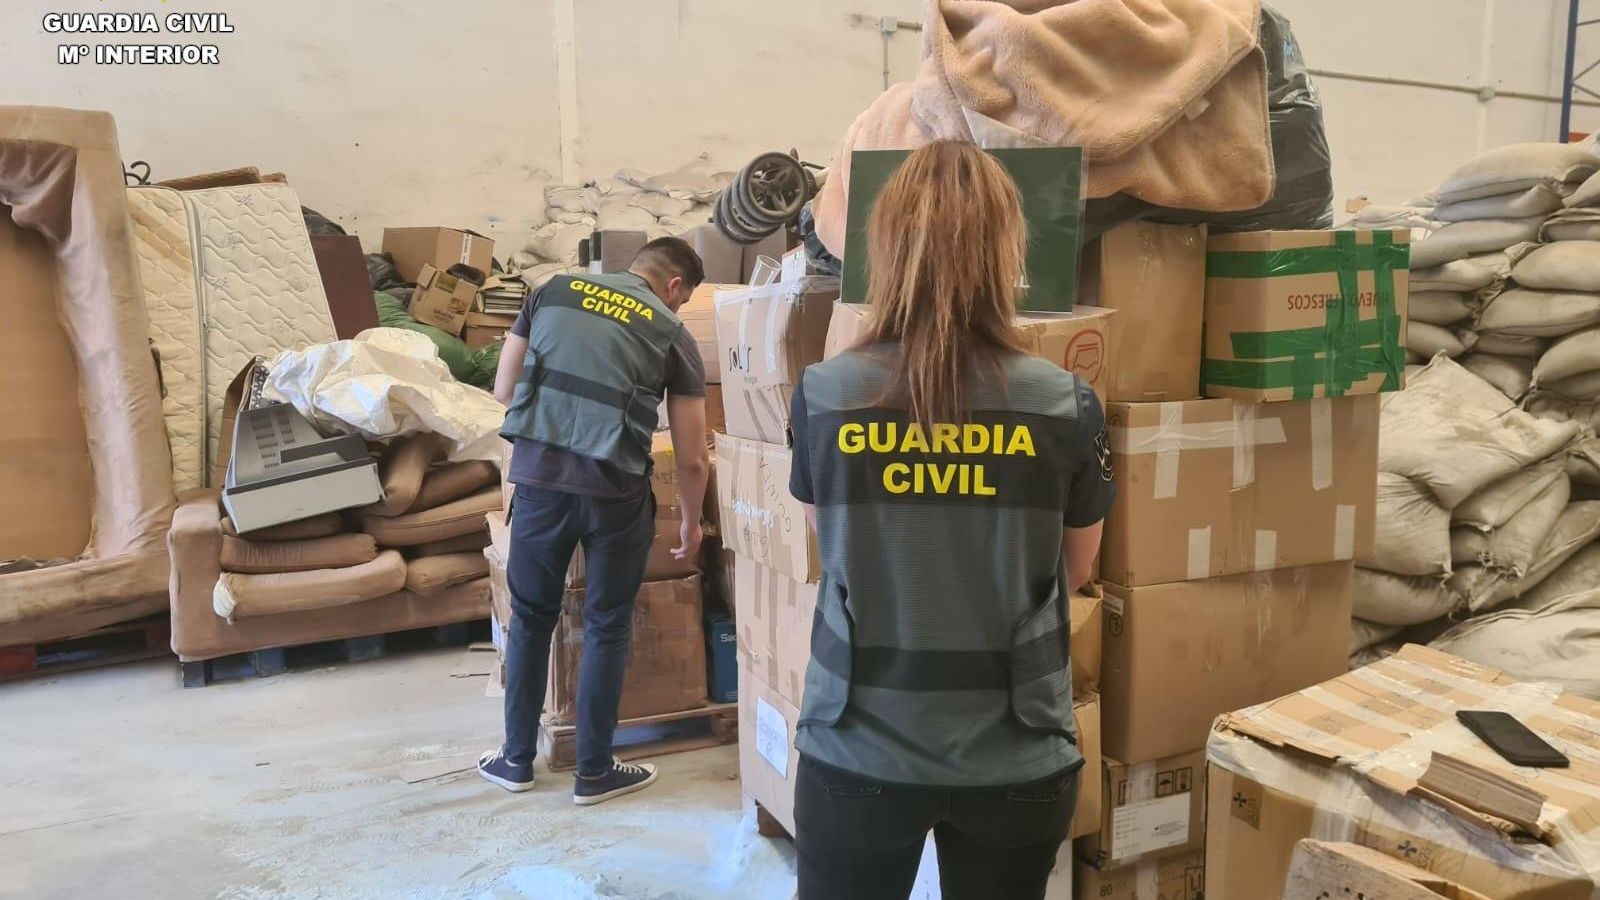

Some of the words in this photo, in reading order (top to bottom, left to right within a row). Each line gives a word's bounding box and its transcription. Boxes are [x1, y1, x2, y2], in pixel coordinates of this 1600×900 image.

[569, 280, 653, 321] GUARDIA
[582, 297, 631, 323] CIVIL
[838, 422, 1037, 457] GUARDIA
[882, 462, 996, 496] CIVIL
